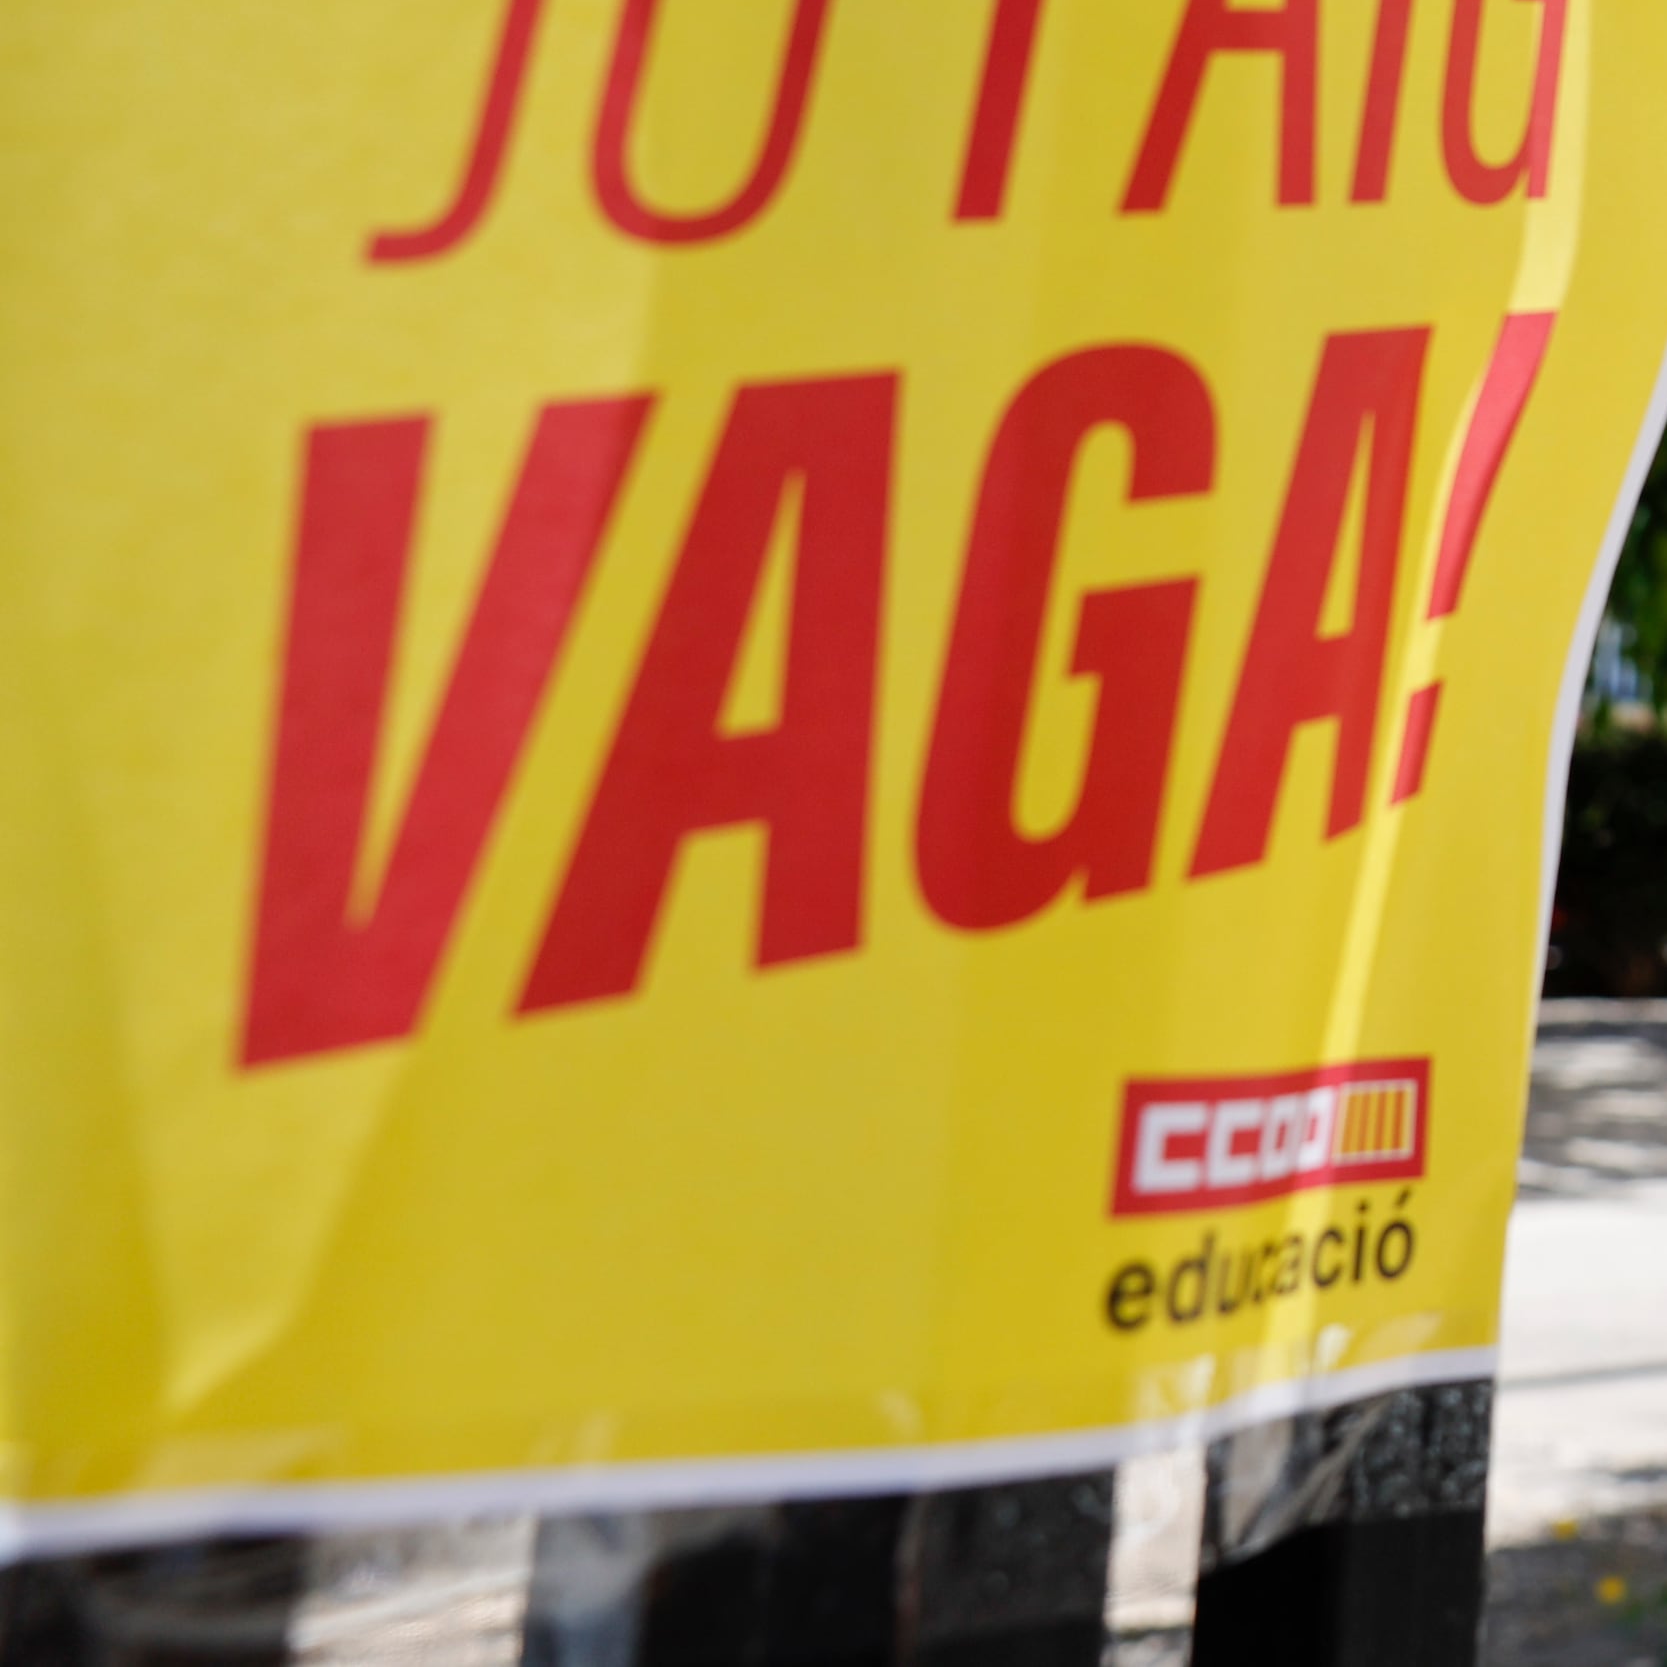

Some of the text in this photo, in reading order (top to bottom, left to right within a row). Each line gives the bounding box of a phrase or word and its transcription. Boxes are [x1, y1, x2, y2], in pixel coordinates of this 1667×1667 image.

[232, 309, 1559, 1074] VAGA!
[1132, 1086, 1336, 1194] CCOO
[1105, 1187, 1415, 1332] educació
